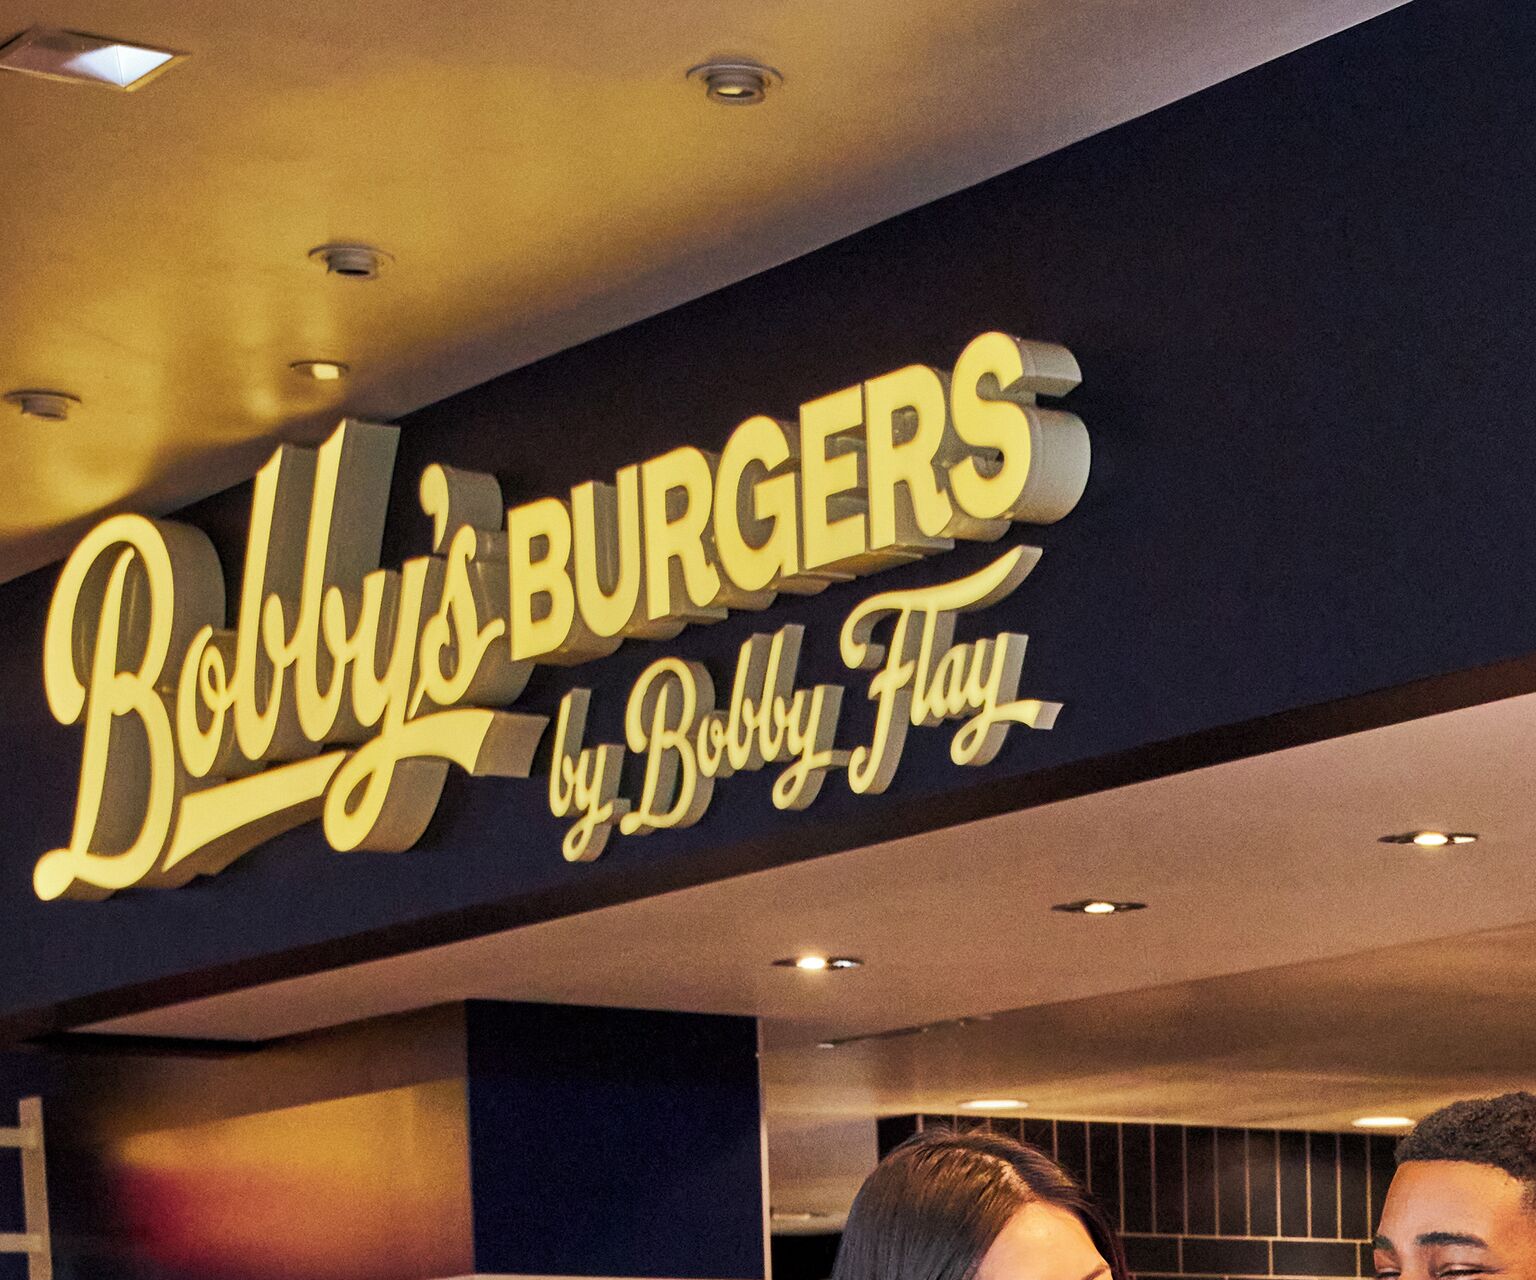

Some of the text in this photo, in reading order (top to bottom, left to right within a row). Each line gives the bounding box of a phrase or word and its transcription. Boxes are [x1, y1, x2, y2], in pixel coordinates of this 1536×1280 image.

[33, 332, 1034, 900] Bobby's BURGERS
[550, 546, 1063, 862] by Bobby Flay
